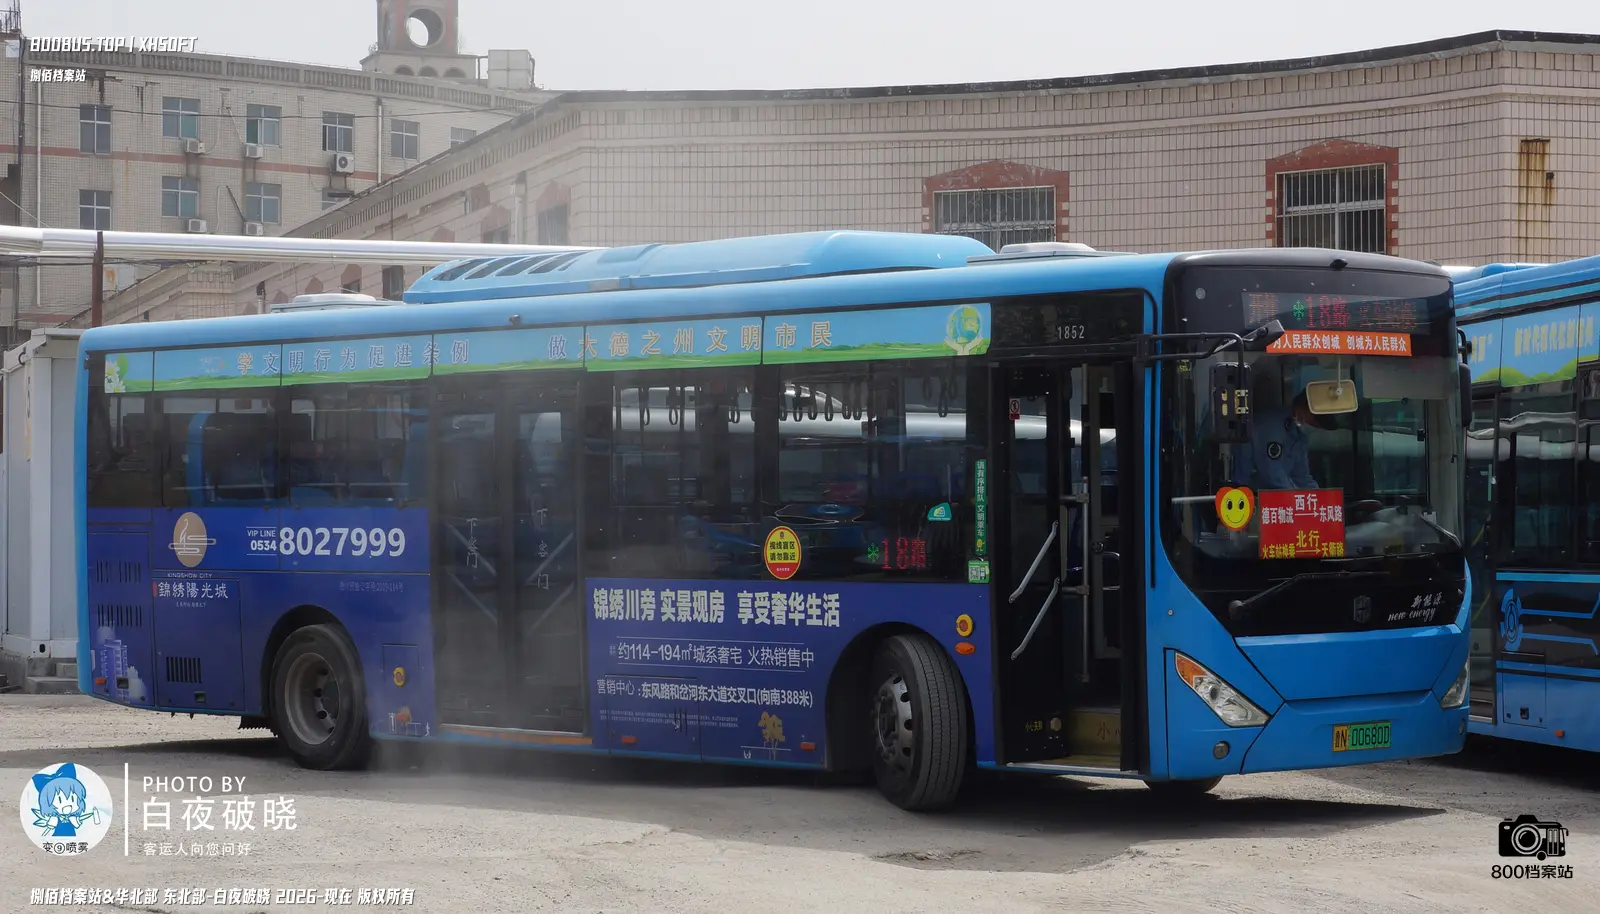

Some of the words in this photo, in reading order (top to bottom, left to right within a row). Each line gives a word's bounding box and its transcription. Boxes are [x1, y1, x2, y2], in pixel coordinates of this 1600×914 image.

[1057, 325, 1085, 339] 1852
[238, 339, 470, 376] 学文明行为促进条例
[547, 321, 833, 361] 做大德之州文明市民
[1347, 335, 1407, 352] 创城为人民群众
[977, 461, 985, 502] 请有序排队
[1294, 493, 1318, 511] 西行
[977, 504, 985, 537] 文明乘车
[1262, 506, 1294, 525] 德百物流
[1319, 505, 1343, 523] 东风路
[250, 539, 277, 552] 0534
[279, 527, 406, 557] 8027999
[259, 530, 276, 538] LINE
[1296, 530, 1320, 548] 北行
[769, 541, 796, 550] 视线盲区
[770, 552, 796, 561] 请勿靠近
[593, 588, 656, 621] 锦绣川旁
[660, 589, 725, 623] 实景现房
[737, 590, 841, 627] 享受奢华生活
[1411, 592, 1443, 608] 新能源
[1388, 612, 1407, 622] new
[1409, 608, 1436, 622] energy
[747, 647, 815, 668] 火热销售中
